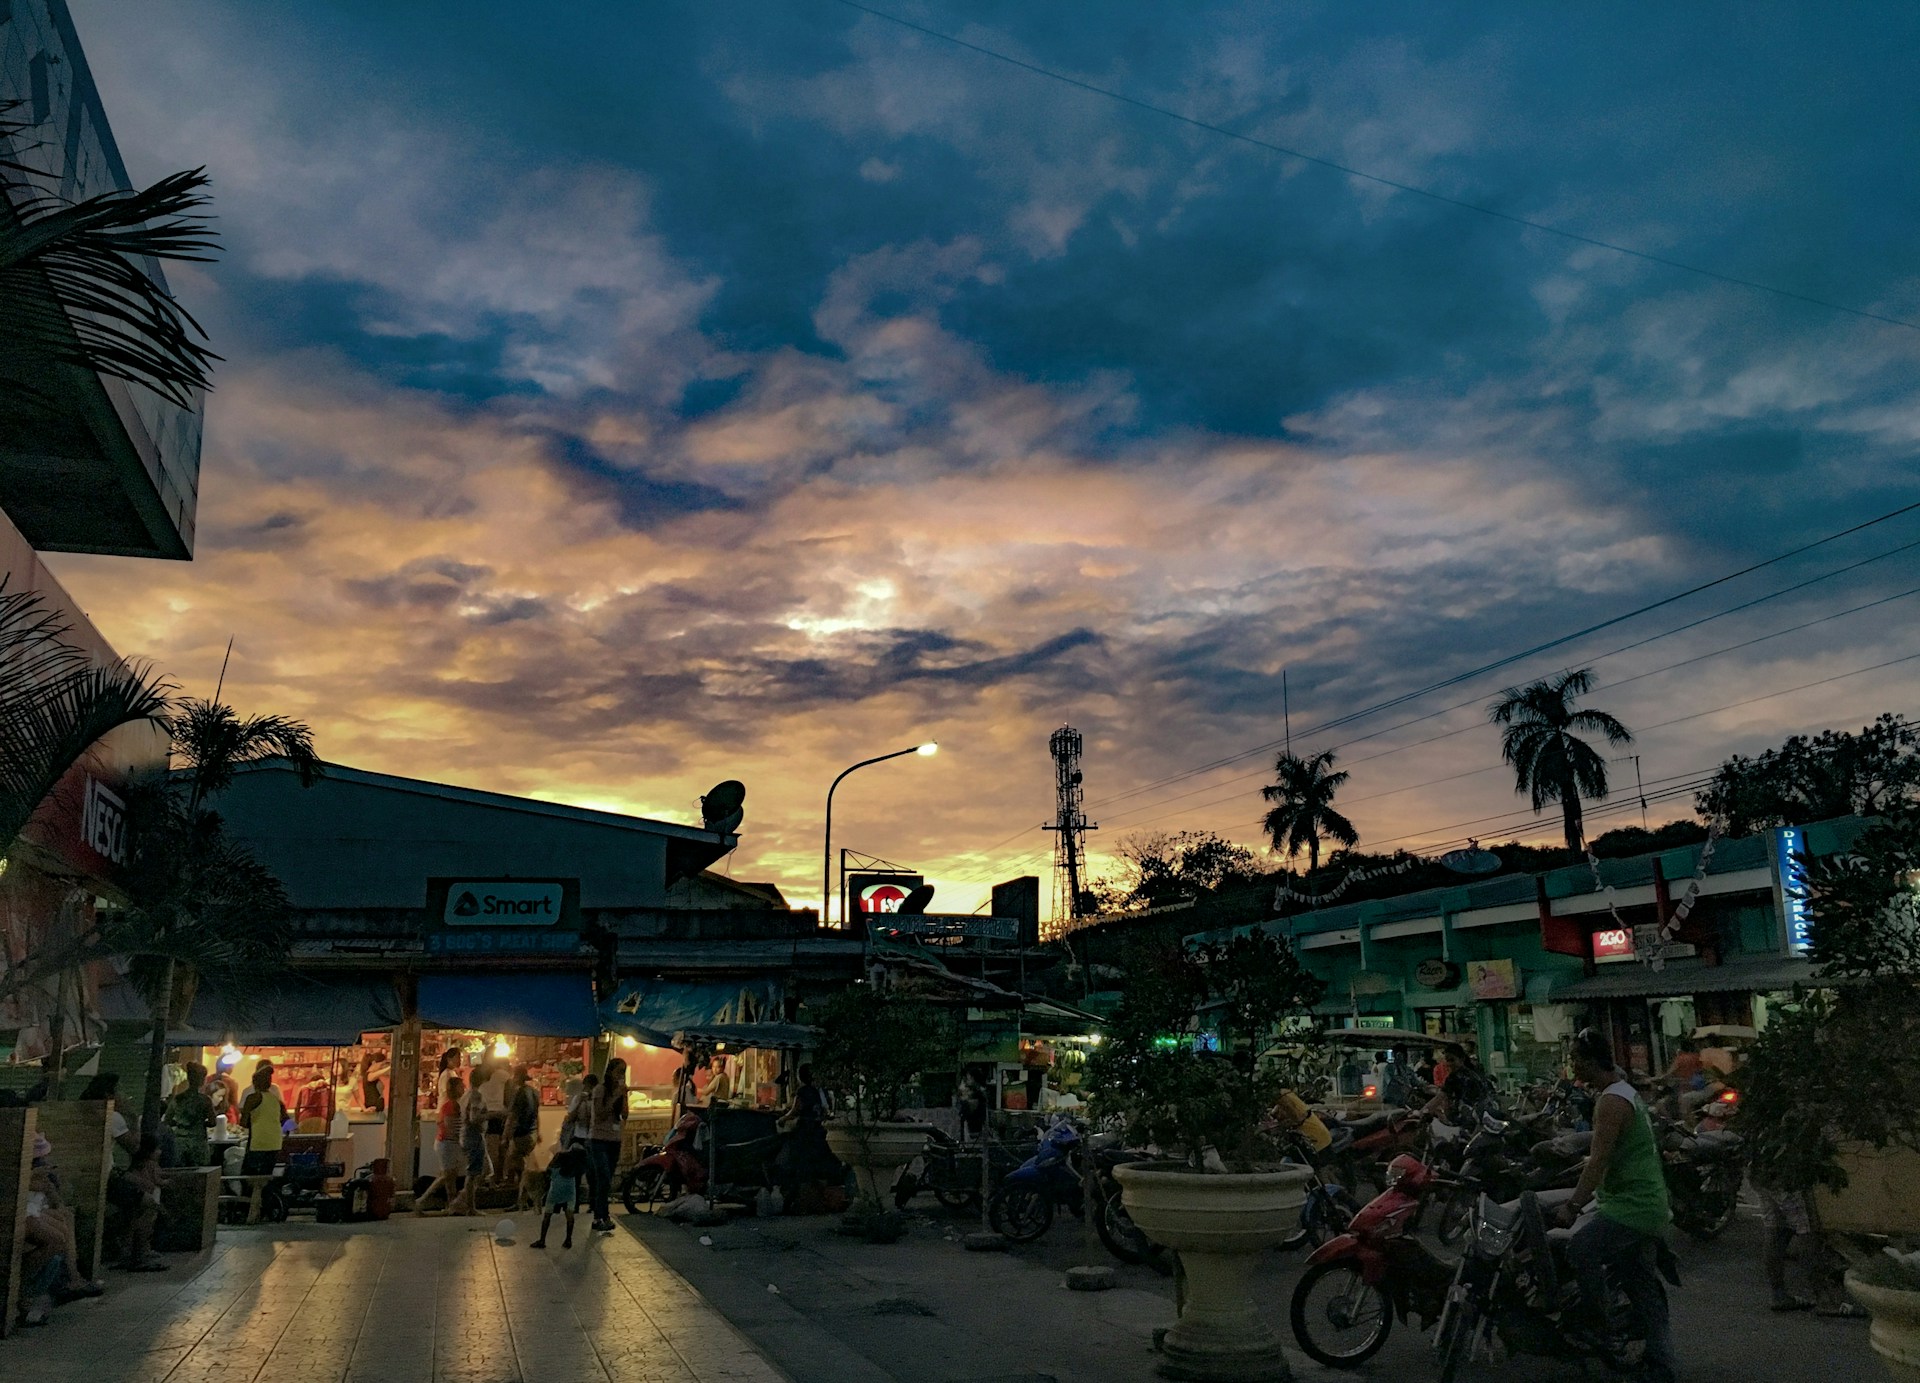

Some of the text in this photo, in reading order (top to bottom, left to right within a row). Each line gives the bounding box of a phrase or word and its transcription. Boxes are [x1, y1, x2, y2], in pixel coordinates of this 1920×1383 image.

[483, 895, 552, 915] Smart
[499, 932, 536, 949] MEAT
[541, 932, 579, 949] SHOP
[1599, 929, 1626, 946] 2GO
